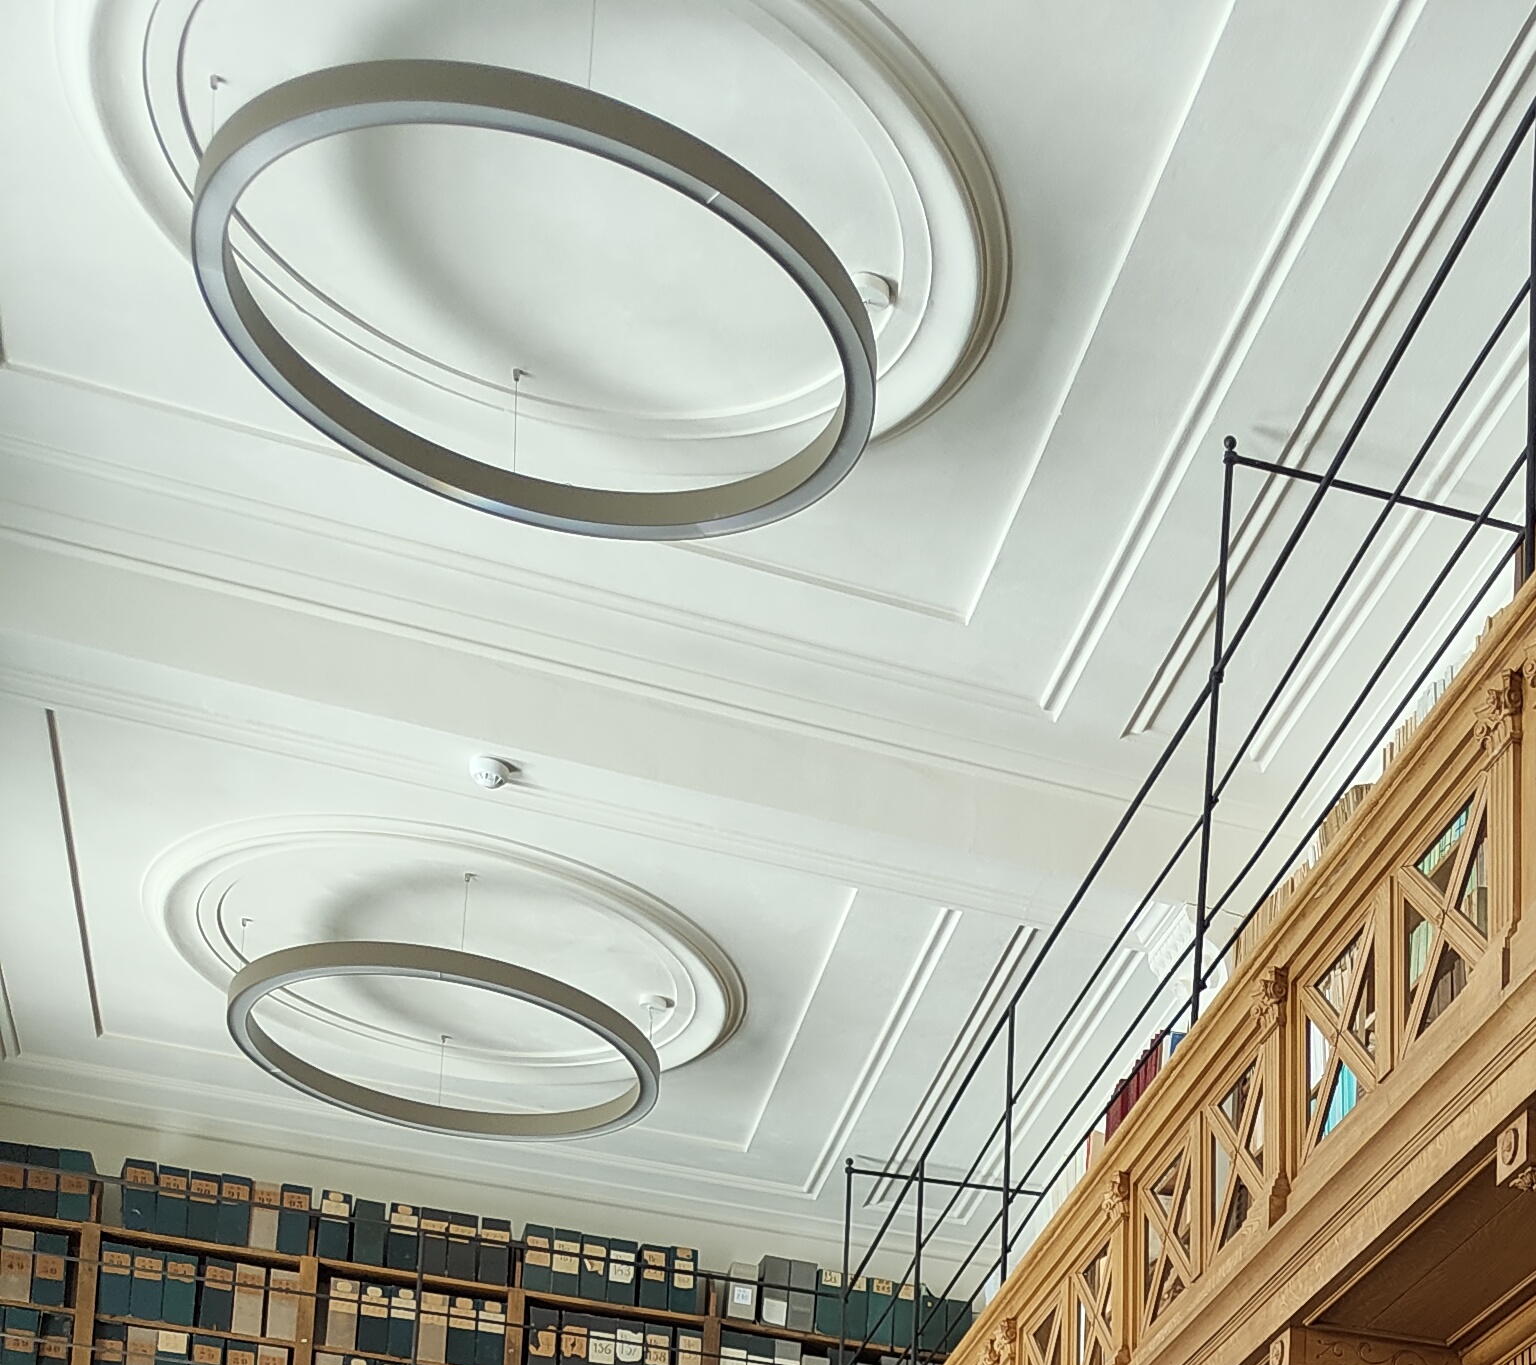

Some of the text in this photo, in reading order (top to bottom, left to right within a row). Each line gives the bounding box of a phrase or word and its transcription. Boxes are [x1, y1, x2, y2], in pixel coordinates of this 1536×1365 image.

[611, 1265, 632, 1278] 163
[592, 1342, 613, 1356] 156
[645, 1349, 667, 1363] 158
